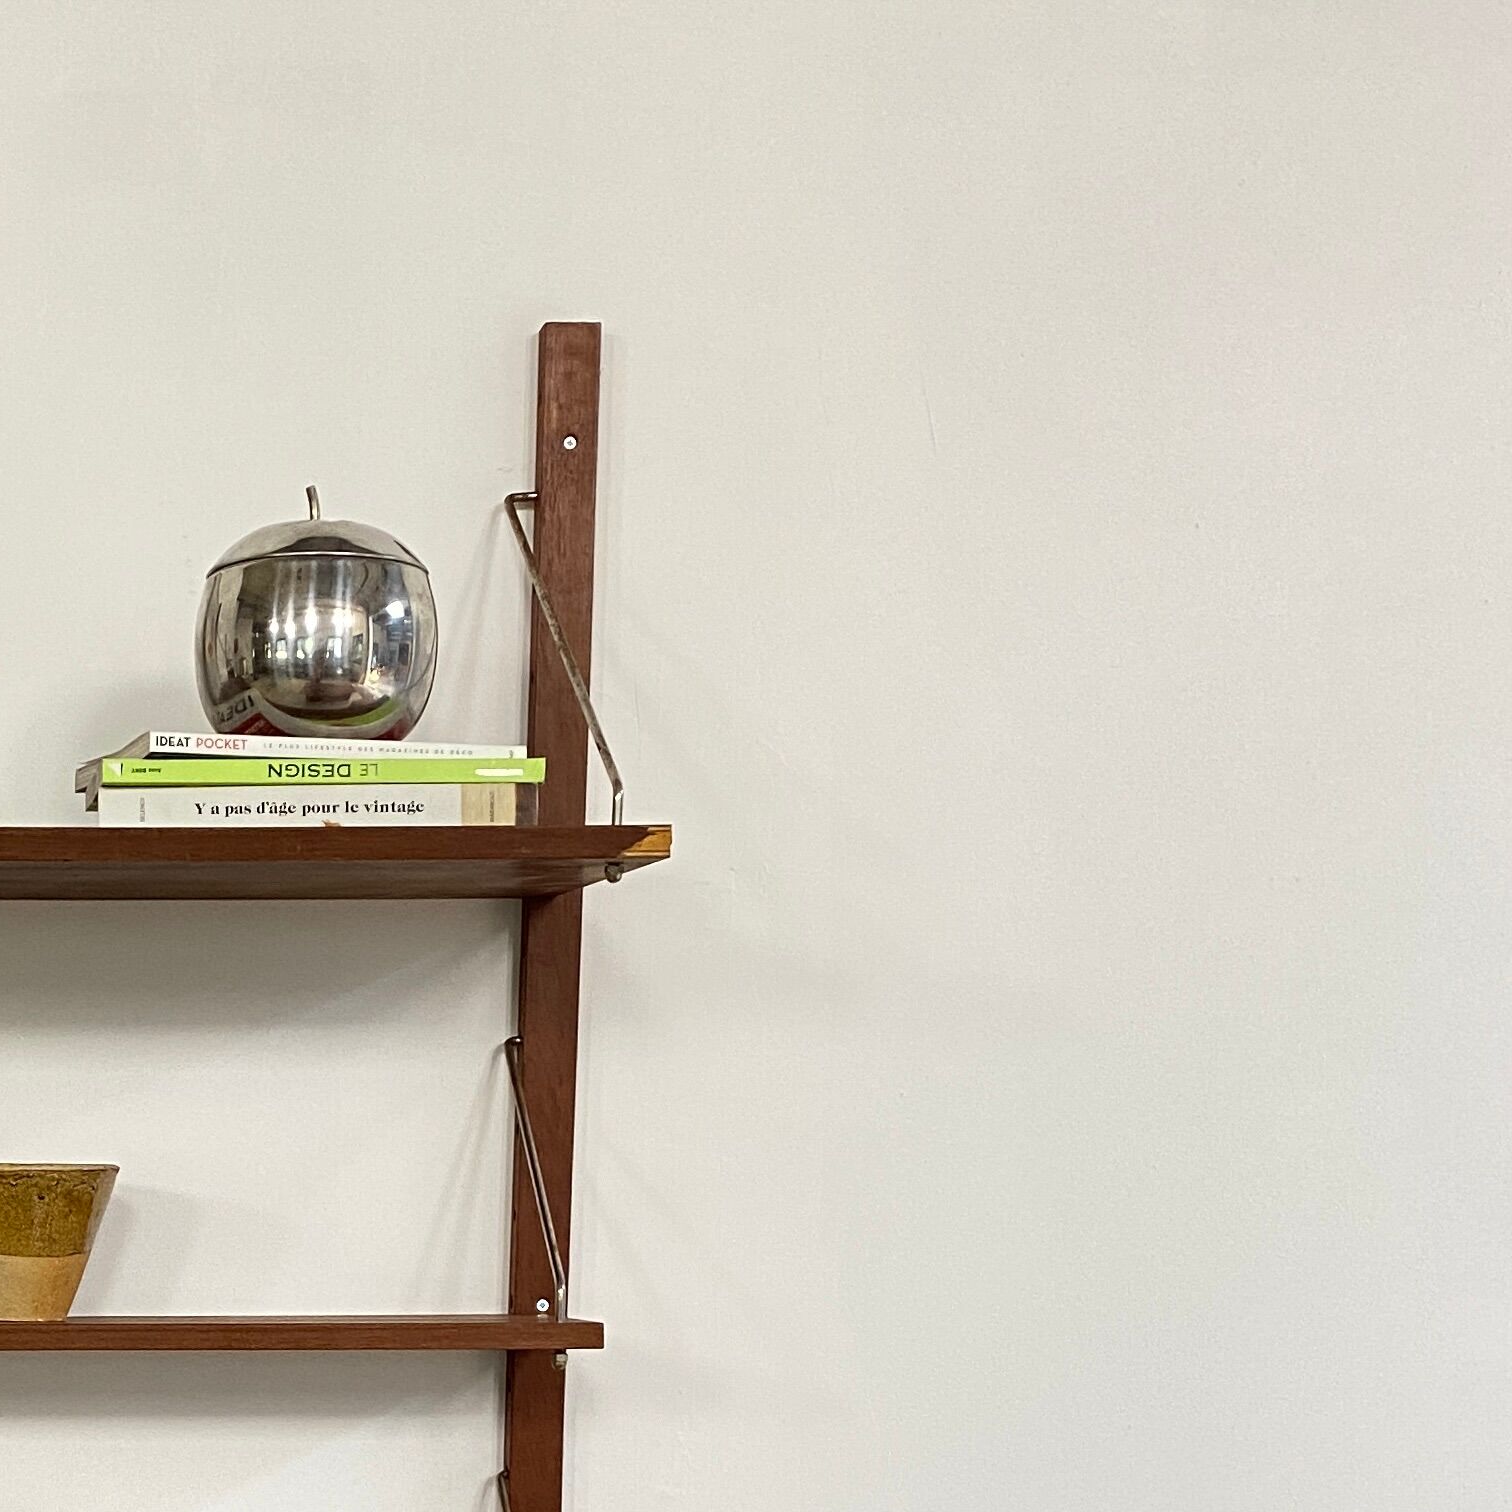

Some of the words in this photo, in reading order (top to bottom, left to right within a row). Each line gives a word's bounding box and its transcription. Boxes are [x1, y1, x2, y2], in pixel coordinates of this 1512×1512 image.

[155, 735, 192, 749] IDEAT
[195, 737, 248, 751] POCKET
[268, 764, 351, 778] DESIGN
[360, 764, 378, 776] LE
[195, 803, 204, 815] Y
[210, 805, 220, 815] a
[224, 805, 252, 819] pas
[302, 804, 338, 818] pour
[345, 801, 359, 814] le
[363, 801, 425, 817] vintage
